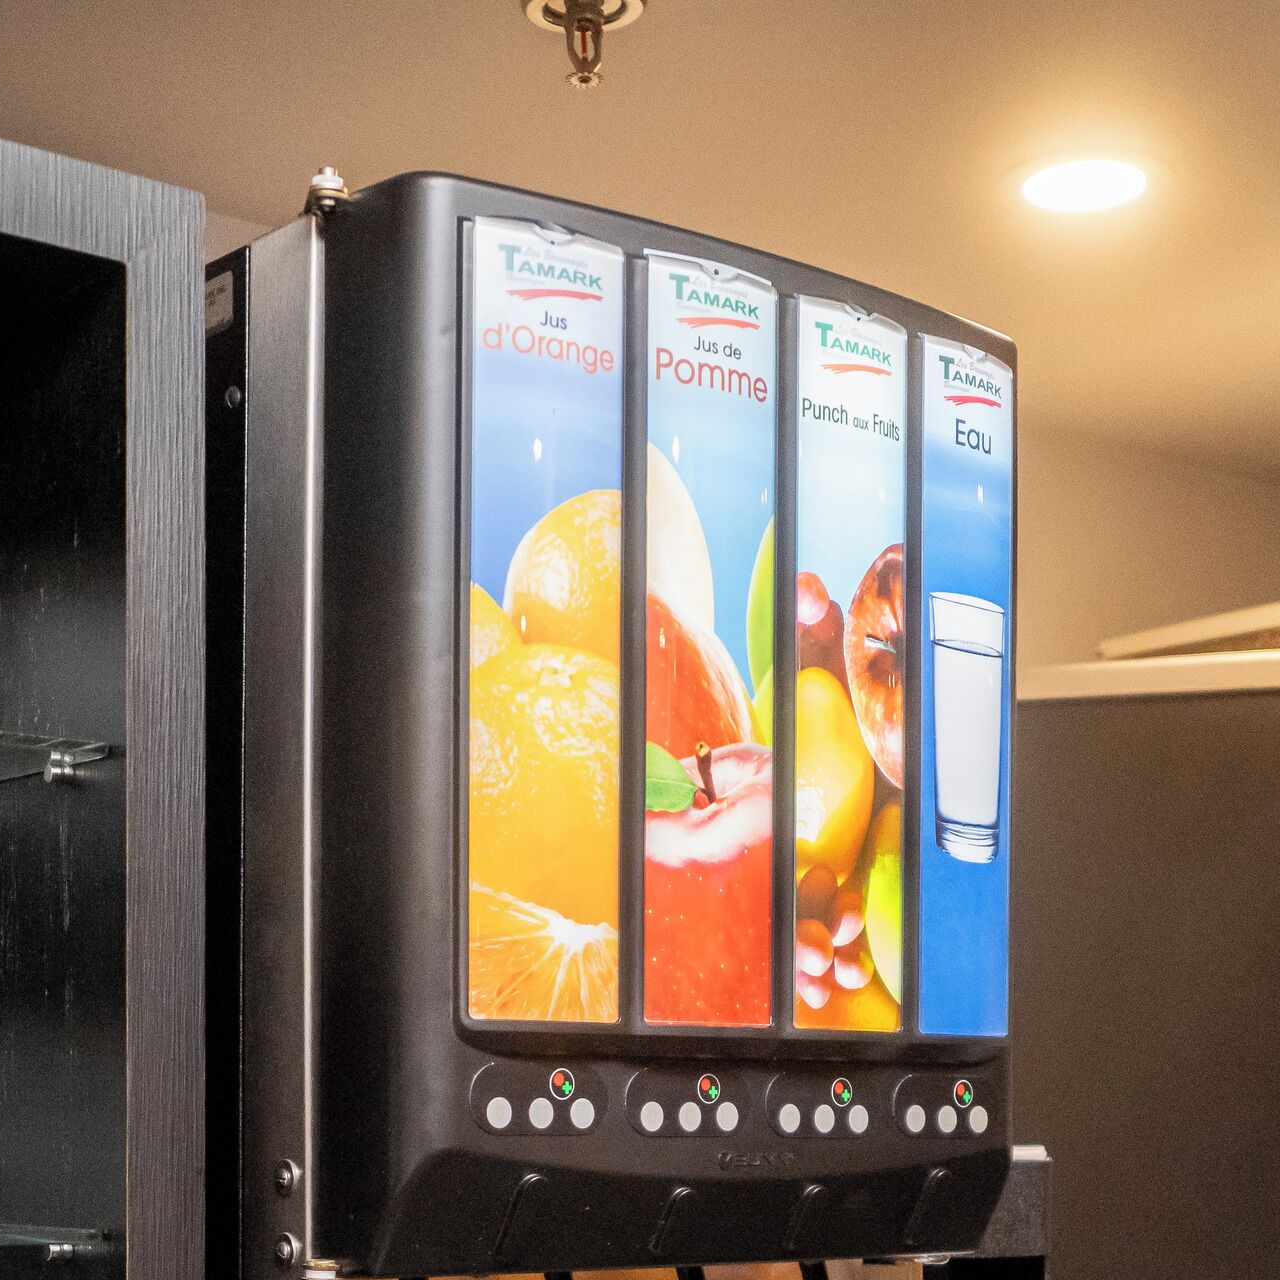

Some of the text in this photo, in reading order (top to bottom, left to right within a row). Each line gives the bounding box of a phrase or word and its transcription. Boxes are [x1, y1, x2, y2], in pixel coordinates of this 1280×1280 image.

[498, 243, 603, 291] TAMARK
[669, 272, 759, 320] TAMARK
[540, 310, 568, 330] Jus
[483, 323, 614, 374] d'Orange
[693, 336, 742, 360] Jus de
[815, 321, 892, 367] TAMARK
[655, 347, 767, 402] Pomme
[939, 355, 1002, 399] TAMARK
[802, 397, 900, 441] Punch aux Fruits
[955, 418, 991, 455] Eau
